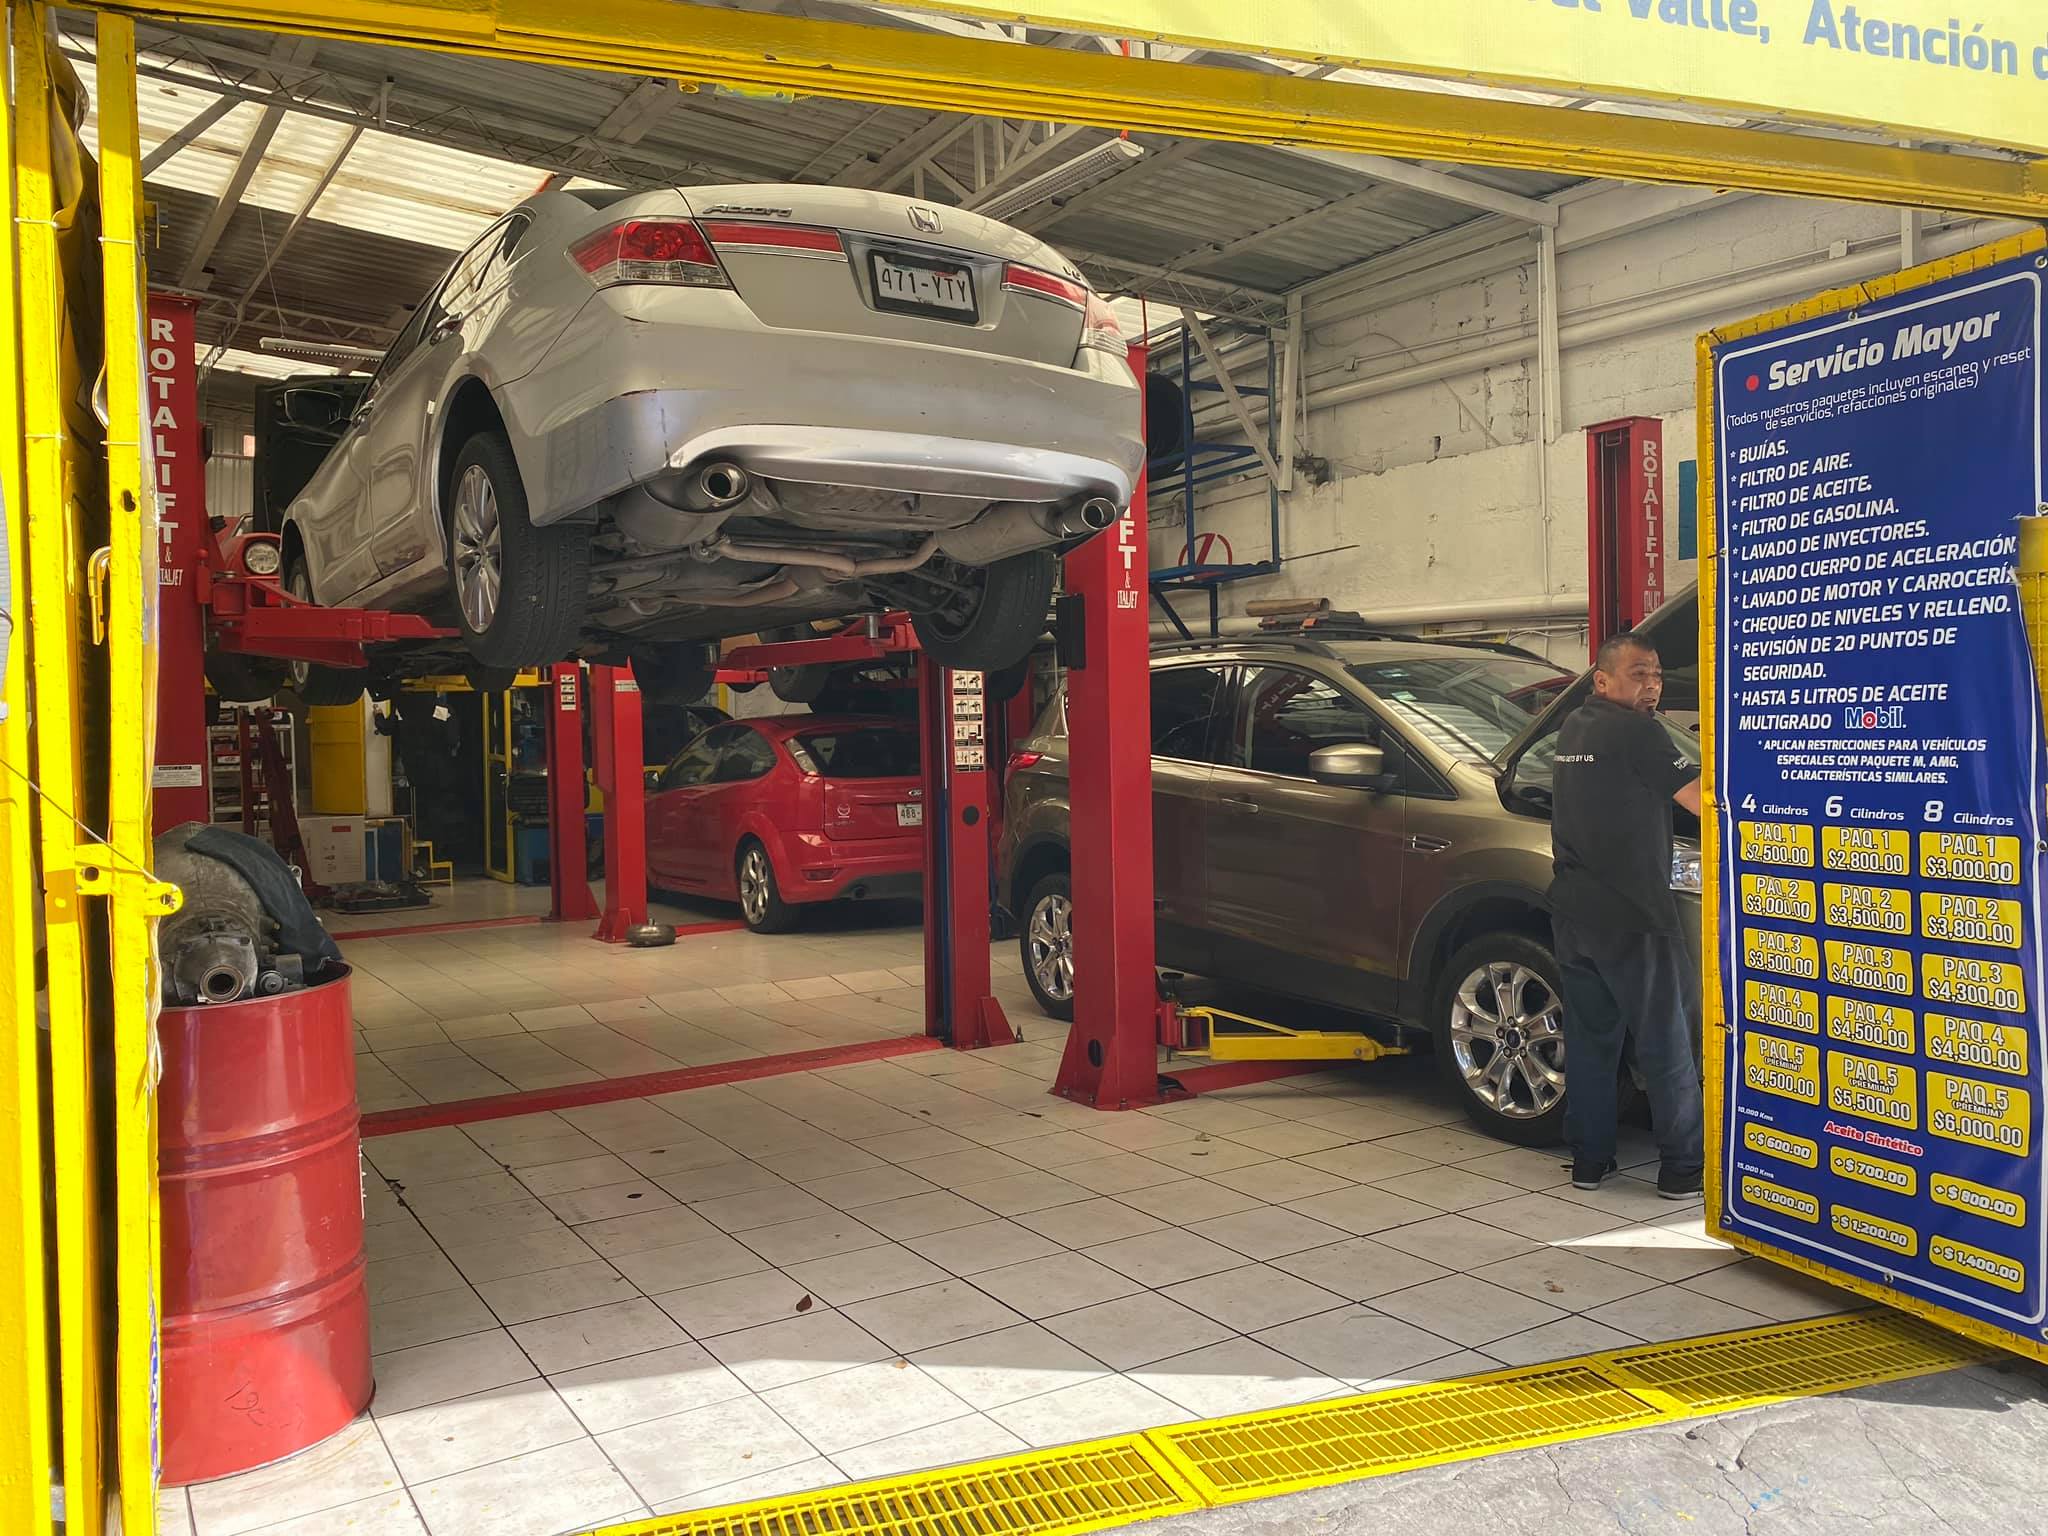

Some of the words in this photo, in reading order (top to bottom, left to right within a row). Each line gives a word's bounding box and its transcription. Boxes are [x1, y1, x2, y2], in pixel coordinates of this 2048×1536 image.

[1802, 0, 2018, 76] Atención
[702, 203, 792, 218] Accord
[882, 268, 966, 302] 471-YTY
[1767, 337, 1885, 391] Servicio
[1891, 310, 2001, 360] Mayor
[1726, 413, 1758, 431] (Todos
[1760, 400, 1811, 421] nuestros
[1812, 387, 1866, 412] paquetes
[1868, 373, 1921, 397] incluyen
[1923, 361, 1979, 383] escaneo
[1982, 357, 1991, 373] y
[1993, 347, 2031, 366] reset
[1765, 416, 1779, 431] de
[1780, 404, 1834, 428] servicios,
[1837, 391, 1907, 415] refacciones
[1910, 373, 1979, 400] originales)
[150, 318, 179, 544] ROTALIFT
[1739, 440, 1789, 464] BUJÍAS.
[1739, 466, 1785, 488] FILTRO
[1789, 461, 1808, 478] DE
[1811, 452, 1853, 475] AIRE.
[1642, 440, 1659, 568] ROTALIFT
[1740, 490, 1786, 513] FILTRO
[1790, 485, 1809, 502] DE
[1812, 475, 1872, 500] ACEITE.
[1741, 515, 1787, 537] FILTRO
[1790, 511, 1809, 528] DE
[1813, 497, 1899, 525] GASOLINA.
[1741, 540, 1796, 561] LAVADO
[1800, 536, 1820, 552] DE
[1823, 520, 1930, 550] INYECTORES.
[1742, 564, 1797, 585] LAVADO
[1800, 556, 1861, 579] CUERPO
[1865, 552, 1887, 571] DE
[1891, 533, 2017, 567] ACELERACIÓN.
[1648, 572, 1656, 586] &
[1742, 588, 1797, 609] LAVADO
[1800, 586, 1821, 602] DE
[1823, 578, 1882, 601] MOTOR
[1887, 578, 1899, 594] Y
[1742, 611, 1807, 635] CHEQUEO
[1810, 612, 1830, 628] DE
[1834, 603, 1902, 626] NIVELES
[1908, 602, 1920, 620] Y
[1924, 594, 2012, 619] RELLENO.
[1742, 635, 1807, 658] REVISIÓN
[1810, 637, 1831, 653] DE
[1834, 635, 1855, 651] 20
[1859, 629, 1928, 650] PUNTOS
[1932, 627, 1957, 645] DE
[1743, 662, 1826, 682] SEGURIDAD.
[1741, 689, 1786, 706] HASTA
[1790, 688, 1800, 705] 5
[1803, 686, 1858, 704] LITROS
[1861, 685, 1884, 703] DE
[1887, 683, 1948, 702] ACEITE
[1739, 713, 1832, 731] MULTIGRADO
[1763, 739, 1806, 751] APLICAN
[1807, 739, 1886, 751] RESTRICCIONES
[1888, 739, 1919, 751] PARA
[1922, 736, 1987, 751] VEHÍCULOS
[1584, 754, 1594, 762] US
[1777, 754, 1835, 767] ESPECIALES
[1837, 754, 1859, 767] CON
[1860, 755, 1910, 769] PAQUETE
[1929, 756, 1959, 769] AMG,
[1790, 768, 1882, 782] CARACTERÍSTICAS
[1884, 771, 1948, 784] SIMILARES.
[1741, 793, 1757, 813] 4
[1762, 803, 1809, 817] Cilindros
[1825, 795, 1844, 817] 6
[1850, 807, 1905, 821] Cilindros
[1923, 800, 1944, 823] 8
[1953, 812, 2014, 827] Cilindros
[1753, 823, 1786, 843] PAQ.
[1790, 825, 1797, 843] 1
[1839, 828, 1878, 849] PAQ.
[1882, 831, 1890, 849] 1
[1940, 834, 1983, 857] PAQ.
[1986, 837, 1996, 857] 1
[1746, 840, 1809, 865] $2,500.00
[1828, 850, 1904, 873] $2,800.00
[1926, 857, 2014, 883] $3,000.00
[1756, 877, 1788, 898] PAQ.
[1789, 881, 1799, 898] 2
[1841, 886, 1878, 908] PAQ.
[1880, 890, 1892, 909] 2
[1746, 894, 1811, 919] $3,000.00
[1830, 905, 1905, 931] $3,500.00
[1940, 896, 1984, 919] PAQ.
[1986, 900, 1999, 920] 2
[1758, 931, 1790, 953] PAQ.
[1792, 936, 1801, 953] 3
[1927, 916, 2014, 944] $3,800.00
[1749, 953, 1813, 977] $3,500.00
[1843, 943, 1880, 967] PAQ.
[1882, 948, 1893, 968] 3
[1832, 962, 1906, 992] $4,000.00
[1943, 959, 1987, 983] PAQ.
[1990, 964, 2002, 984] 3
[1759, 984, 1791, 1007] PAQ.
[1791, 991, 1802, 1008] 4
[1929, 978, 2019, 1009] $4,300.00
[1749, 1002, 1813, 1030] $4,000.00
[1844, 1001, 1880, 1024] PAQ.
[1882, 1008, 1894, 1026] 4
[1832, 1018, 1908, 1049] $4,500.00
[1944, 1019, 1989, 1044] PAQ.
[1991, 1026, 2005, 1046] 4
[1759, 1038, 1792, 1063] PAQ.
[1793, 1046, 1804, 1065] 5
[1763, 1056, 1801, 1073] (PREMIUM)
[1932, 1038, 2020, 1070] $4,900.00
[1748, 1065, 1815, 1097] $4,500.00
[1843, 1058, 1884, 1084] PAQ.
[1886, 1067, 1898, 1087] 5
[1848, 1076, 1894, 1095] (PREMIUM)
[1833, 1087, 1911, 1121] $5,500.00
[1946, 1079, 1992, 1109] PAQ.
[1996, 1089, 2009, 1110] 5
[1951, 1100, 2004, 1119] (PREMIUM)
[1823, 1120, 1864, 1142] Aceite
[1865, 1130, 1924, 1157] Sintético
[1934, 1110, 2022, 1148] $6,000.00
